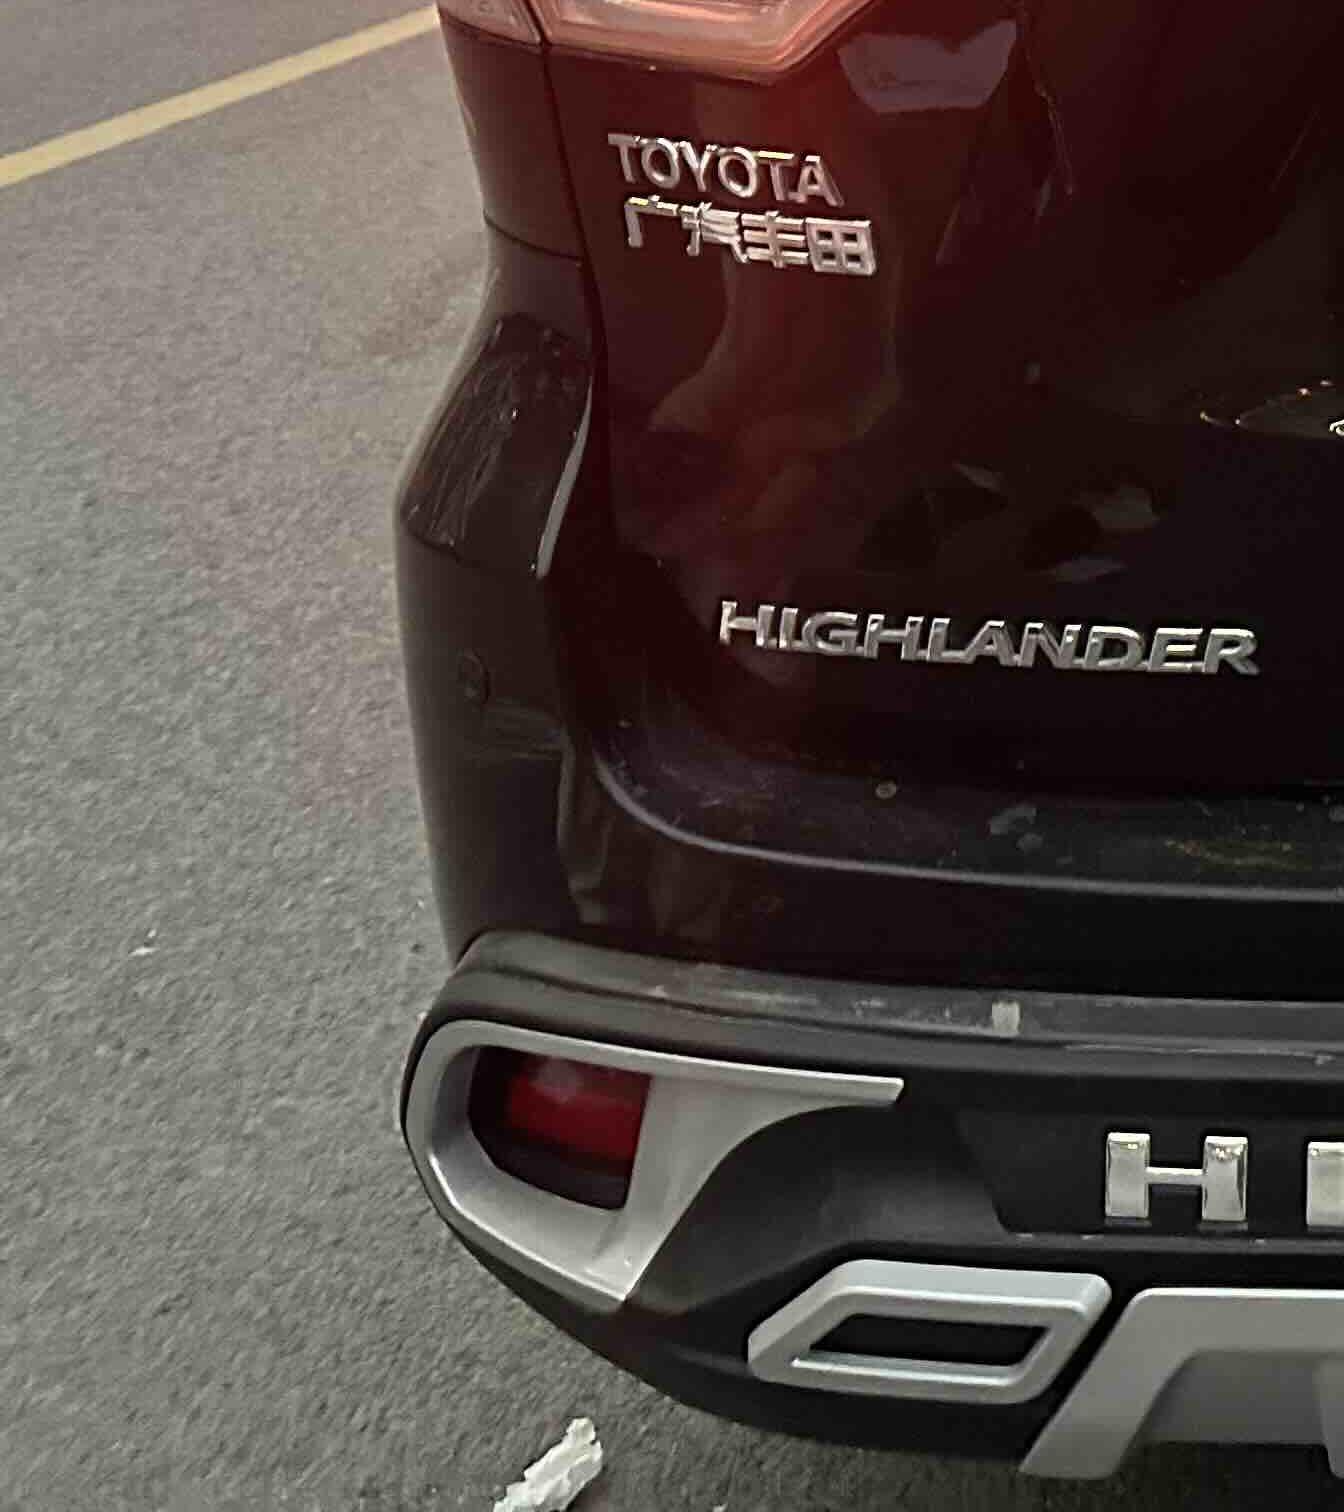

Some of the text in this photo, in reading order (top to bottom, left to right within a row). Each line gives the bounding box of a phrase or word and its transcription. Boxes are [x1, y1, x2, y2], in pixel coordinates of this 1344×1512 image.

[607, 132, 845, 208] TOYOTA
[622, 193, 878, 276] 广汽丰田
[718, 599, 1260, 676] HIGHLANDER
